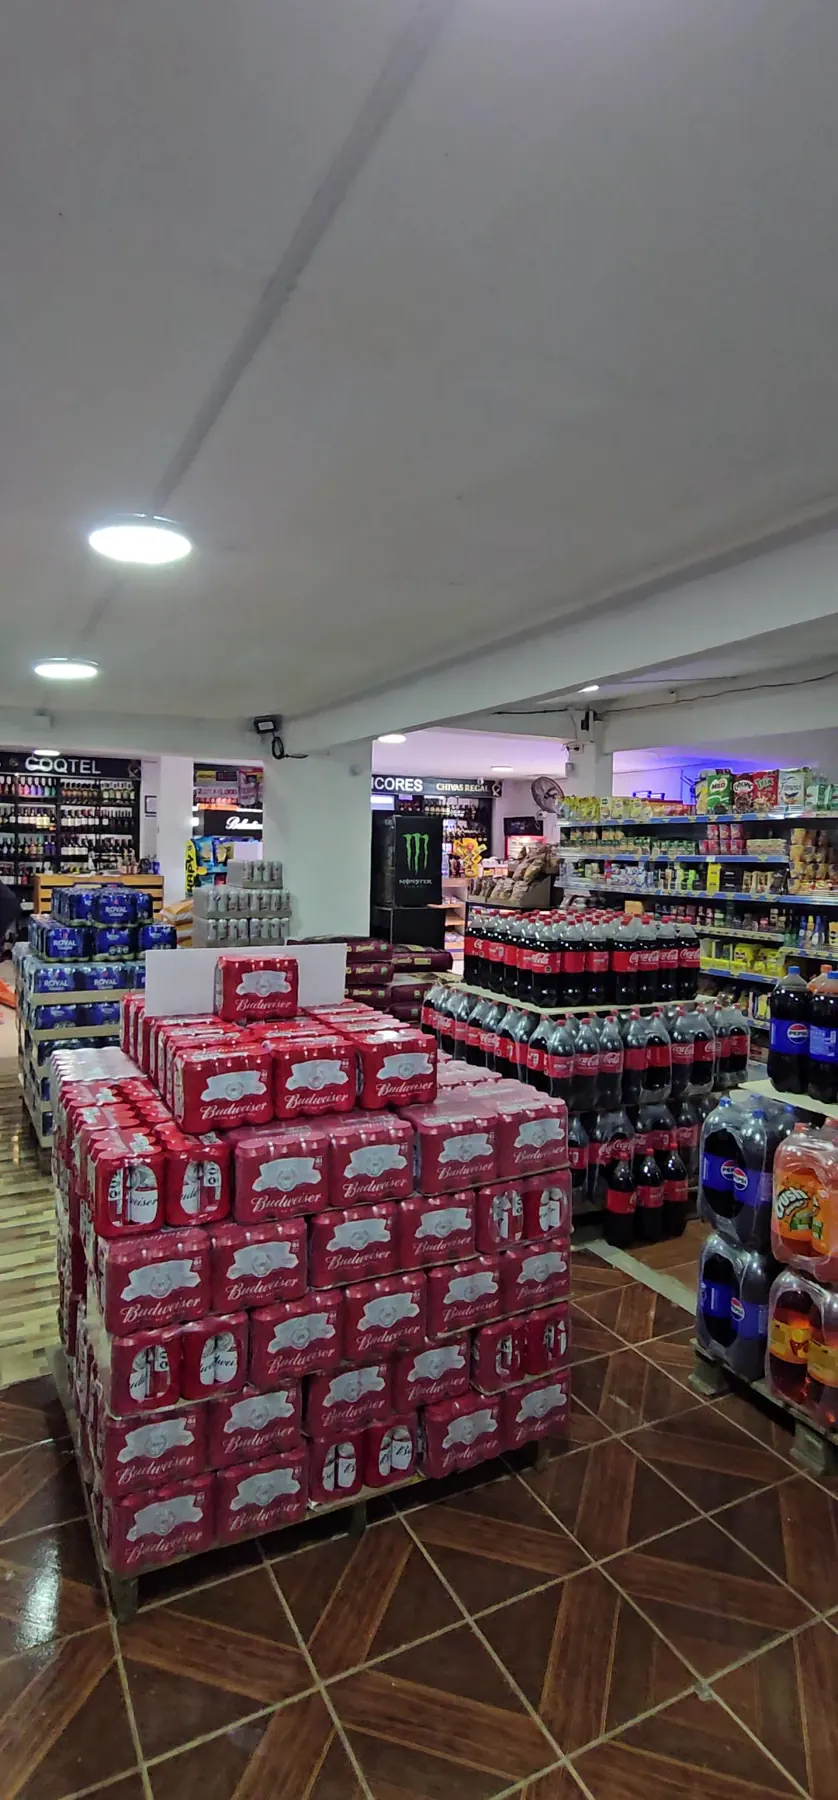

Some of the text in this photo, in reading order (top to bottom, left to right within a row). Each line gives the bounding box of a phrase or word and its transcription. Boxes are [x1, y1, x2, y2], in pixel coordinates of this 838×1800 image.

[25, 757, 101, 774] COQTEL
[436, 783, 463, 792] CHIVAS
[399, 878, 433, 886] MONSTER
[105, 905, 128, 913] ROYAL
[53, 939, 77, 947] ROYAL
[44, 979, 69, 987] ROYAL
[94, 978, 118, 986] ROYAL
[235, 998, 293, 1012] Budweiser
[376, 1080, 435, 1097] Budweiser
[200, 1101, 268, 1120] Budweiser
[284, 1092, 349, 1110] Budweiser
[513, 1146, 566, 1164] Budweiser
[437, 1161, 495, 1181] Budweiser
[342, 1177, 409, 1199] Budweiser
[251, 1192, 322, 1213] Budweiser
[325, 1249, 392, 1271] Budweiser
[226, 1276, 300, 1301] Budweiser
[119, 1296, 202, 1324] Budweiser
[443, 1299, 500, 1322] Budweiser
[356, 1323, 421, 1351] Budweiser
[267, 1347, 337, 1375] Budweiser
[321, 1399, 386, 1427] Budweiser
[223, 1424, 296, 1455] Budweiser
[116, 1455, 196, 1486] Budweiser
[229, 1501, 301, 1532] Budweiser
[124, 1530, 204, 1564] Budweiser
